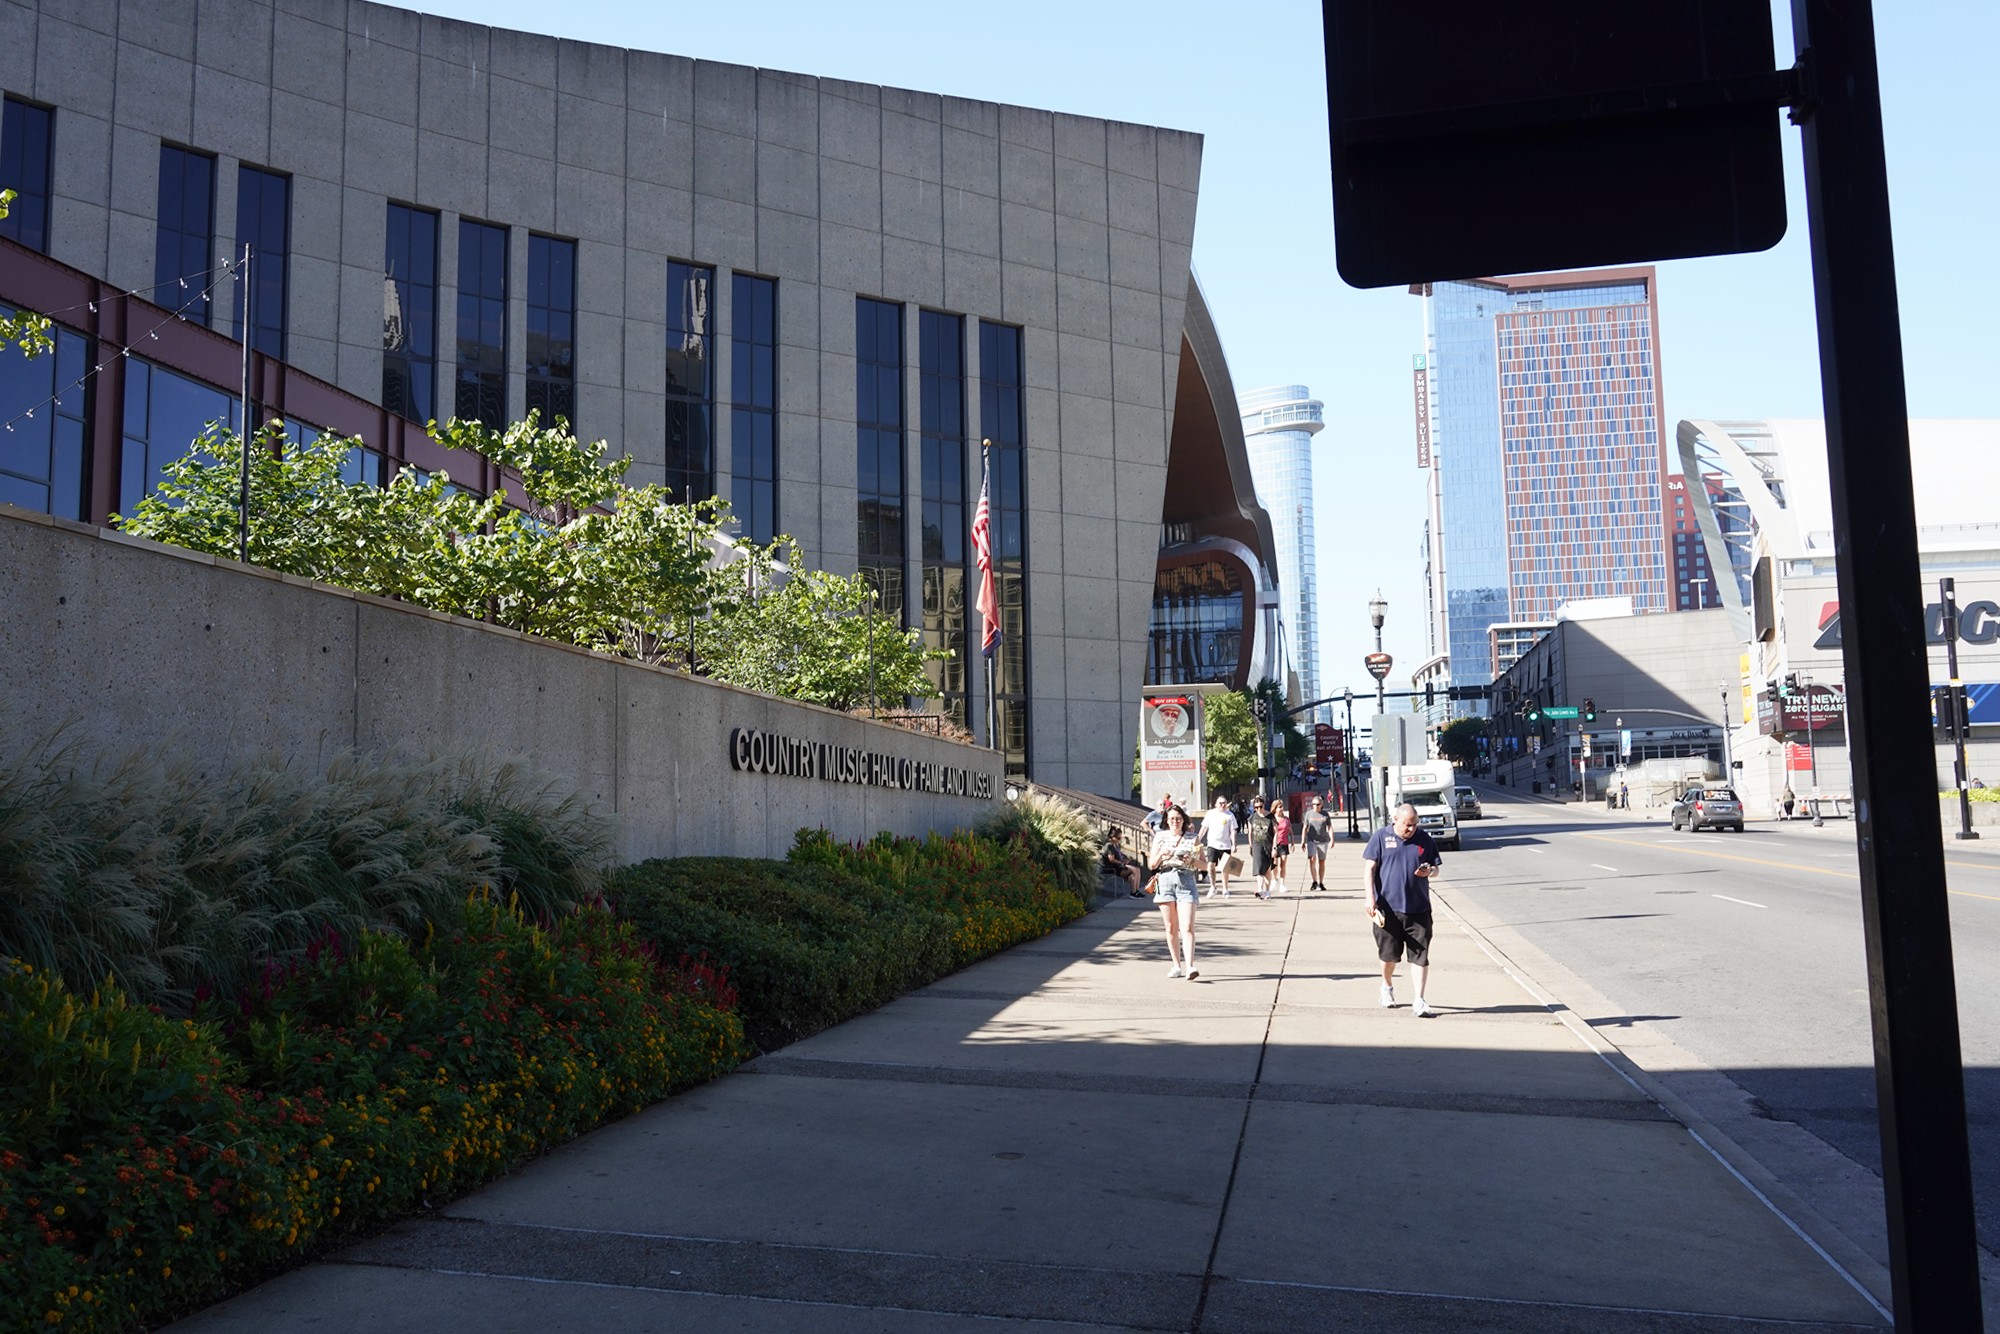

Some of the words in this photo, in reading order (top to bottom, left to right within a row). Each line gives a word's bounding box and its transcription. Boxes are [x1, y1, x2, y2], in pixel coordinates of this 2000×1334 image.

[1416, 374, 1426, 418] EMBASSY
[1419, 421, 1428, 460] SUITES
[1785, 695, 1808, 705] TRY
[1785, 705, 1808, 713] zero
[1811, 704, 1844, 712] SUGAR
[732, 728, 820, 778] COUNTRY
[825, 744, 869, 785] MUSIC
[872, 753, 900, 788] HALL
[902, 758, 917, 791] OF
[920, 761, 945, 793] FAME
[946, 767, 964, 795] AND
[966, 769, 998, 799] MUSEUM
